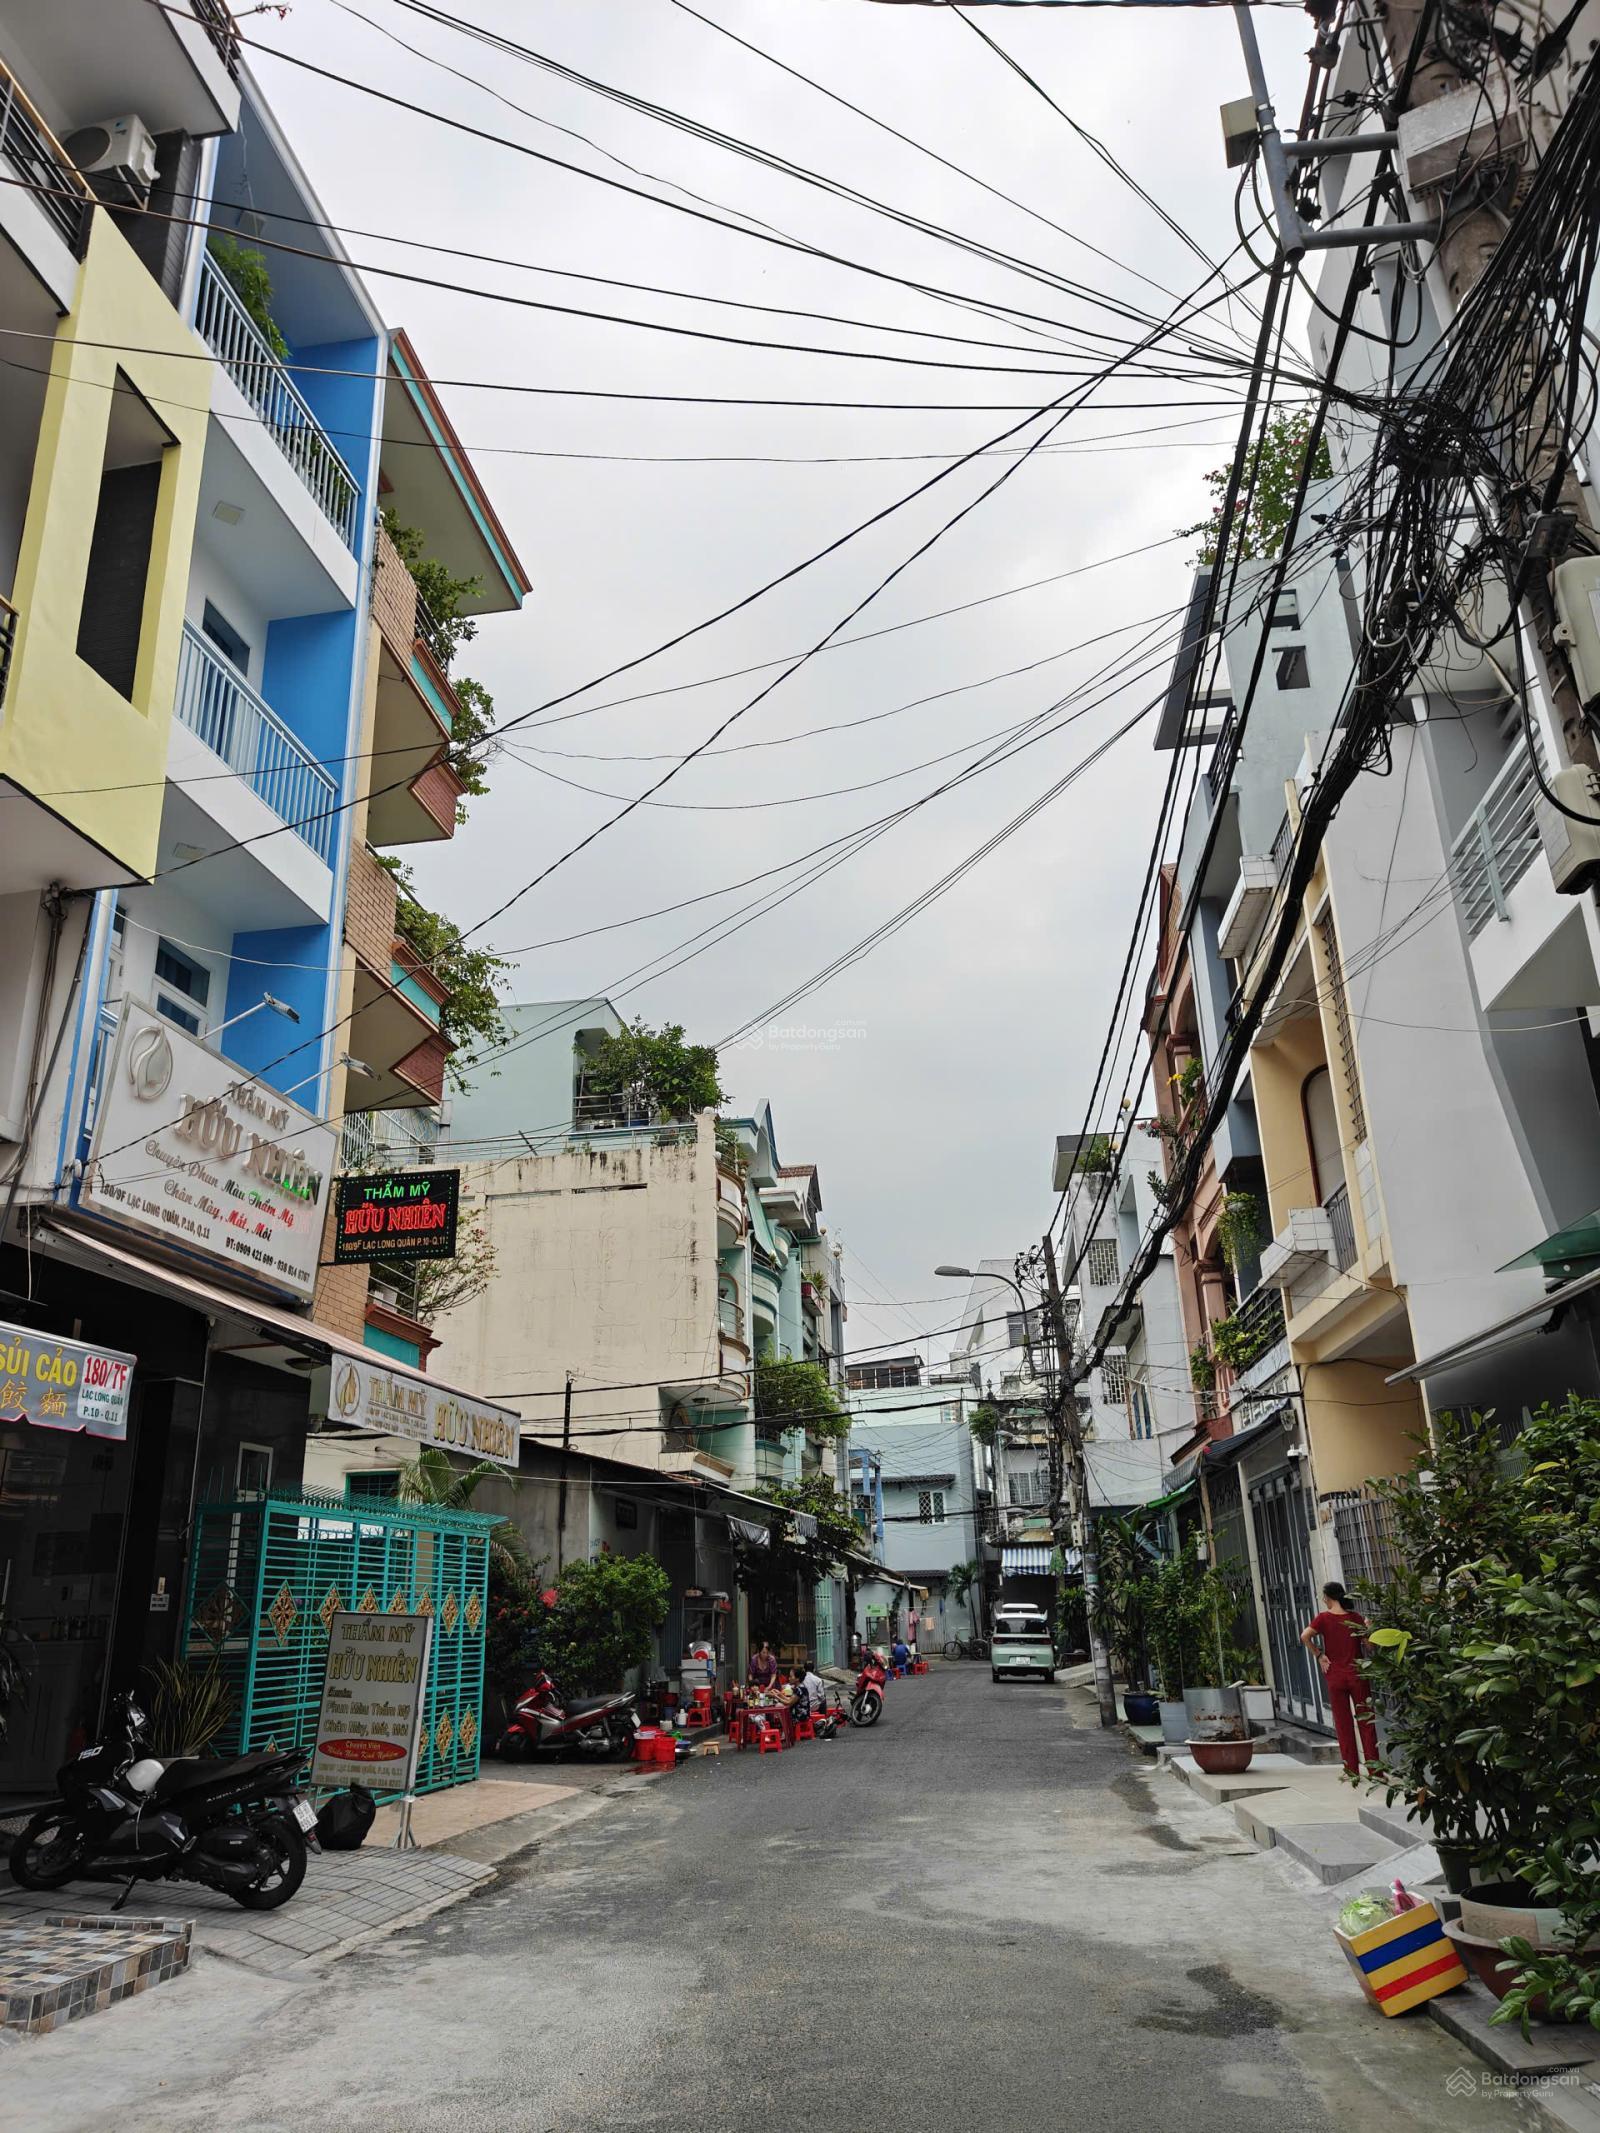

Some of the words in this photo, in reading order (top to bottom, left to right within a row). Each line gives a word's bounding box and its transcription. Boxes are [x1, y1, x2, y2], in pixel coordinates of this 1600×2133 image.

[188, 1161, 219, 1188] Phun
[221, 1178, 246, 1201] Màu
[242, 1132, 323, 1205] NHIÊN
[363, 1178, 405, 1200] THẨM
[409, 1181, 431, 1197] MỸ
[142, 1200, 161, 1218] LONG
[196, 1224, 211, 1240] Q.11
[164, 1179, 193, 1205] Chân
[251, 1222, 273, 1241] Môi
[344, 1202, 386, 1235] HỮU
[387, 1197, 447, 1231] NHIÊN
[251, 1248, 263, 1262] 421
[377, 1239, 396, 1249] LONG
[396, 1235, 416, 1248] QUÂN
[35, 1347, 78, 1387] CẢO
[84, 1354, 128, 1391] 180/7F
[83, 1406, 100, 1418] P.10
[104, 1410, 118, 1422] Q.11
[94, 1390, 110, 1404] LONG
[471, 1412, 515, 1459] NHIÊN
[341, 1617, 386, 1642] THẨM
[387, 1622, 416, 1643] MỸ
[328, 1646, 365, 1681] HỮU
[366, 1647, 418, 1683] NHIÊN
